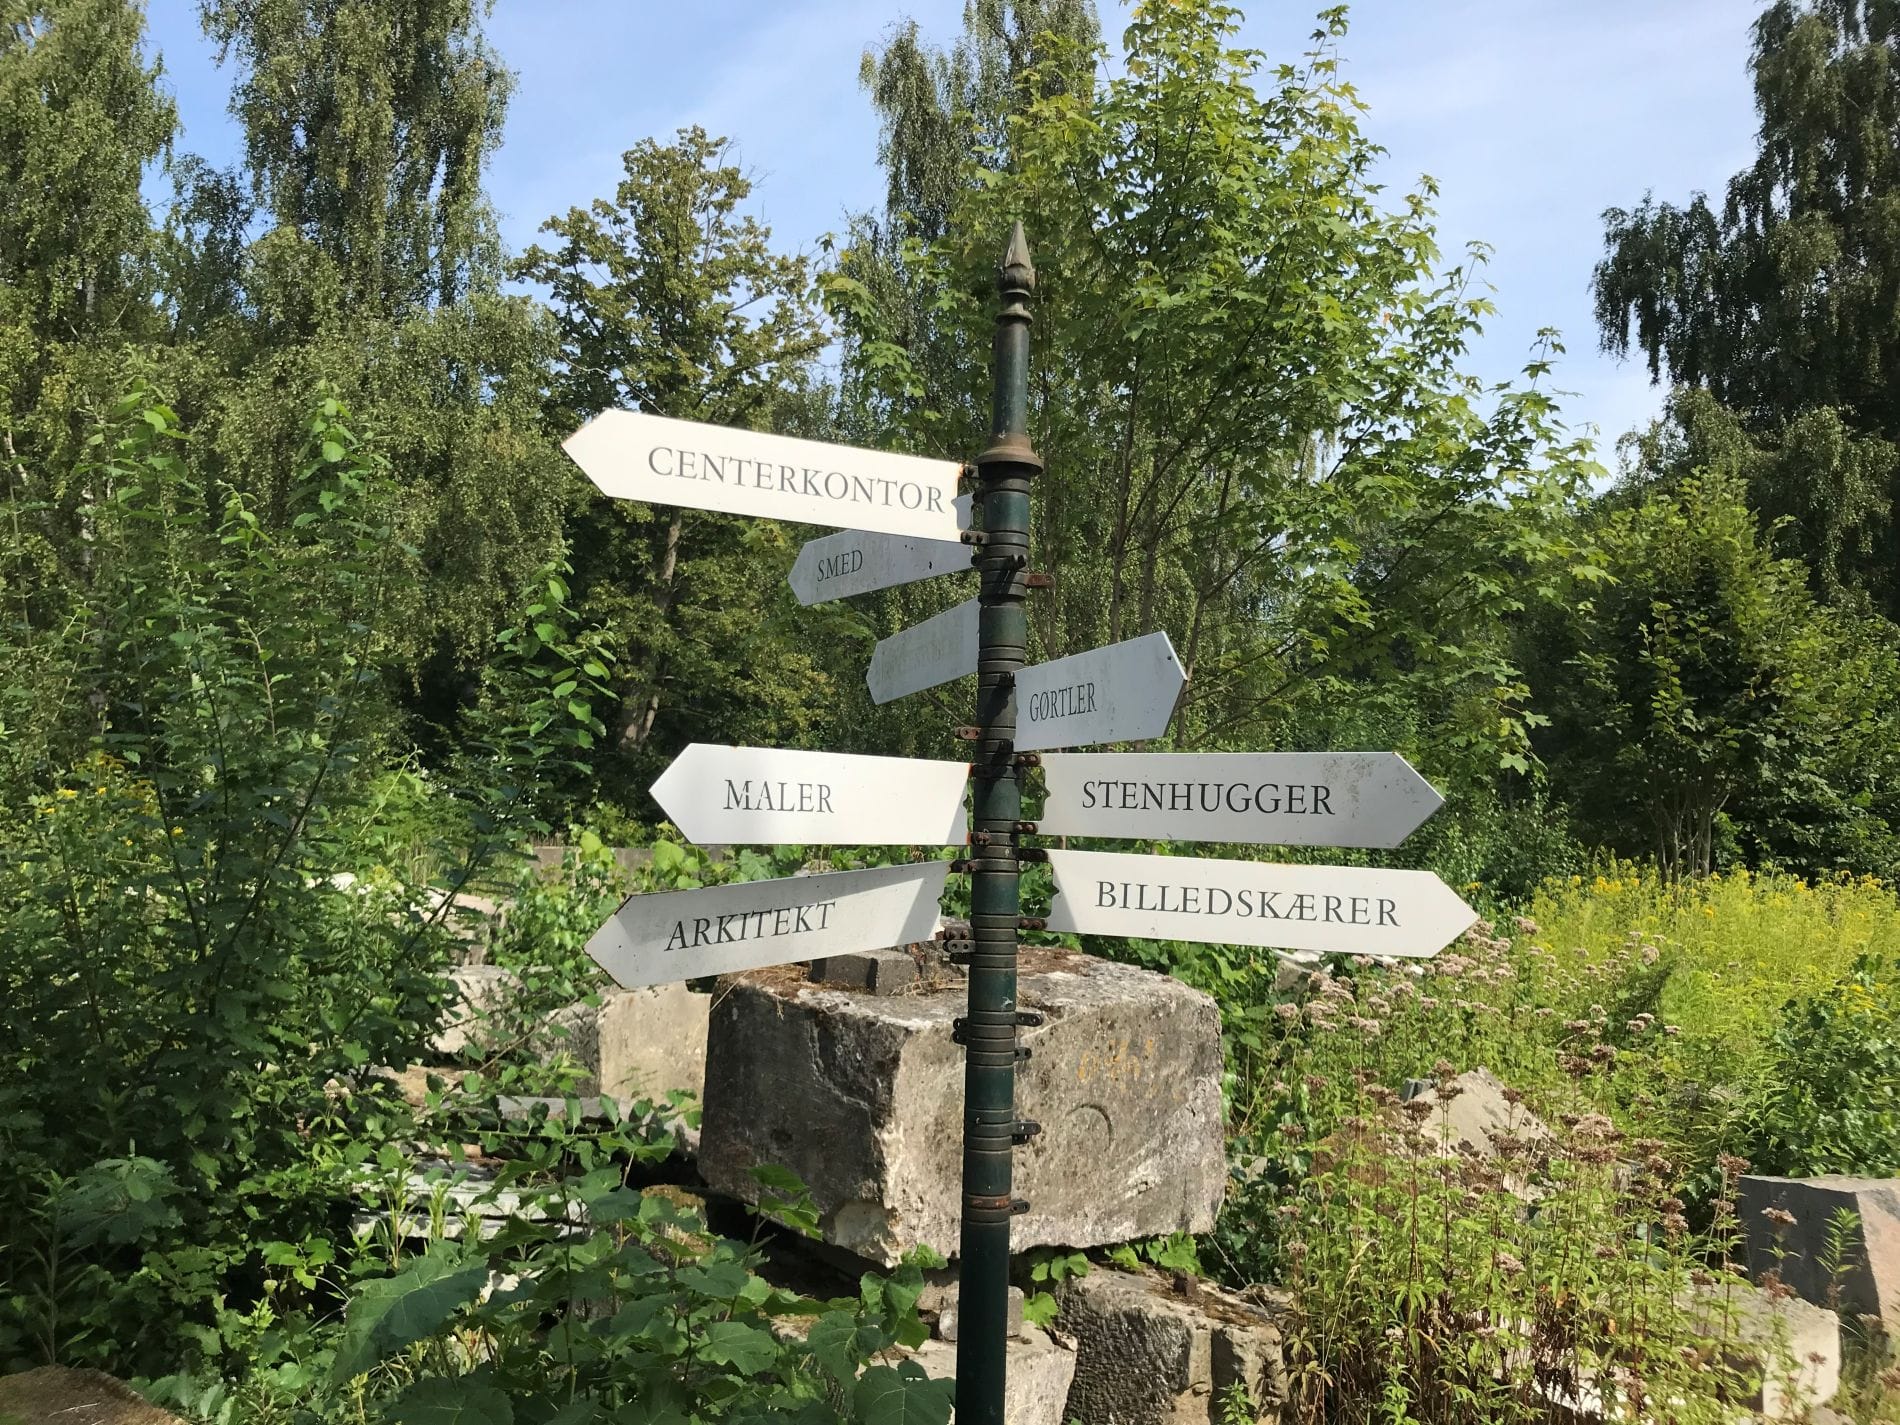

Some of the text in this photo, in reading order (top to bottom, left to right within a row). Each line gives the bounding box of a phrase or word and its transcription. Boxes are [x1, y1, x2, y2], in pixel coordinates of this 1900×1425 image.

[648, 446, 944, 513] CENTERKONTOR
[817, 549, 863, 581] SMED
[1029, 682, 1096, 722] GØRTLER
[723, 779, 834, 813] MALER
[1082, 780, 1335, 815] STENHUGGER
[1095, 881, 1400, 927] BILLEDSKÆRER
[664, 902, 836, 951] ARKITEKT
